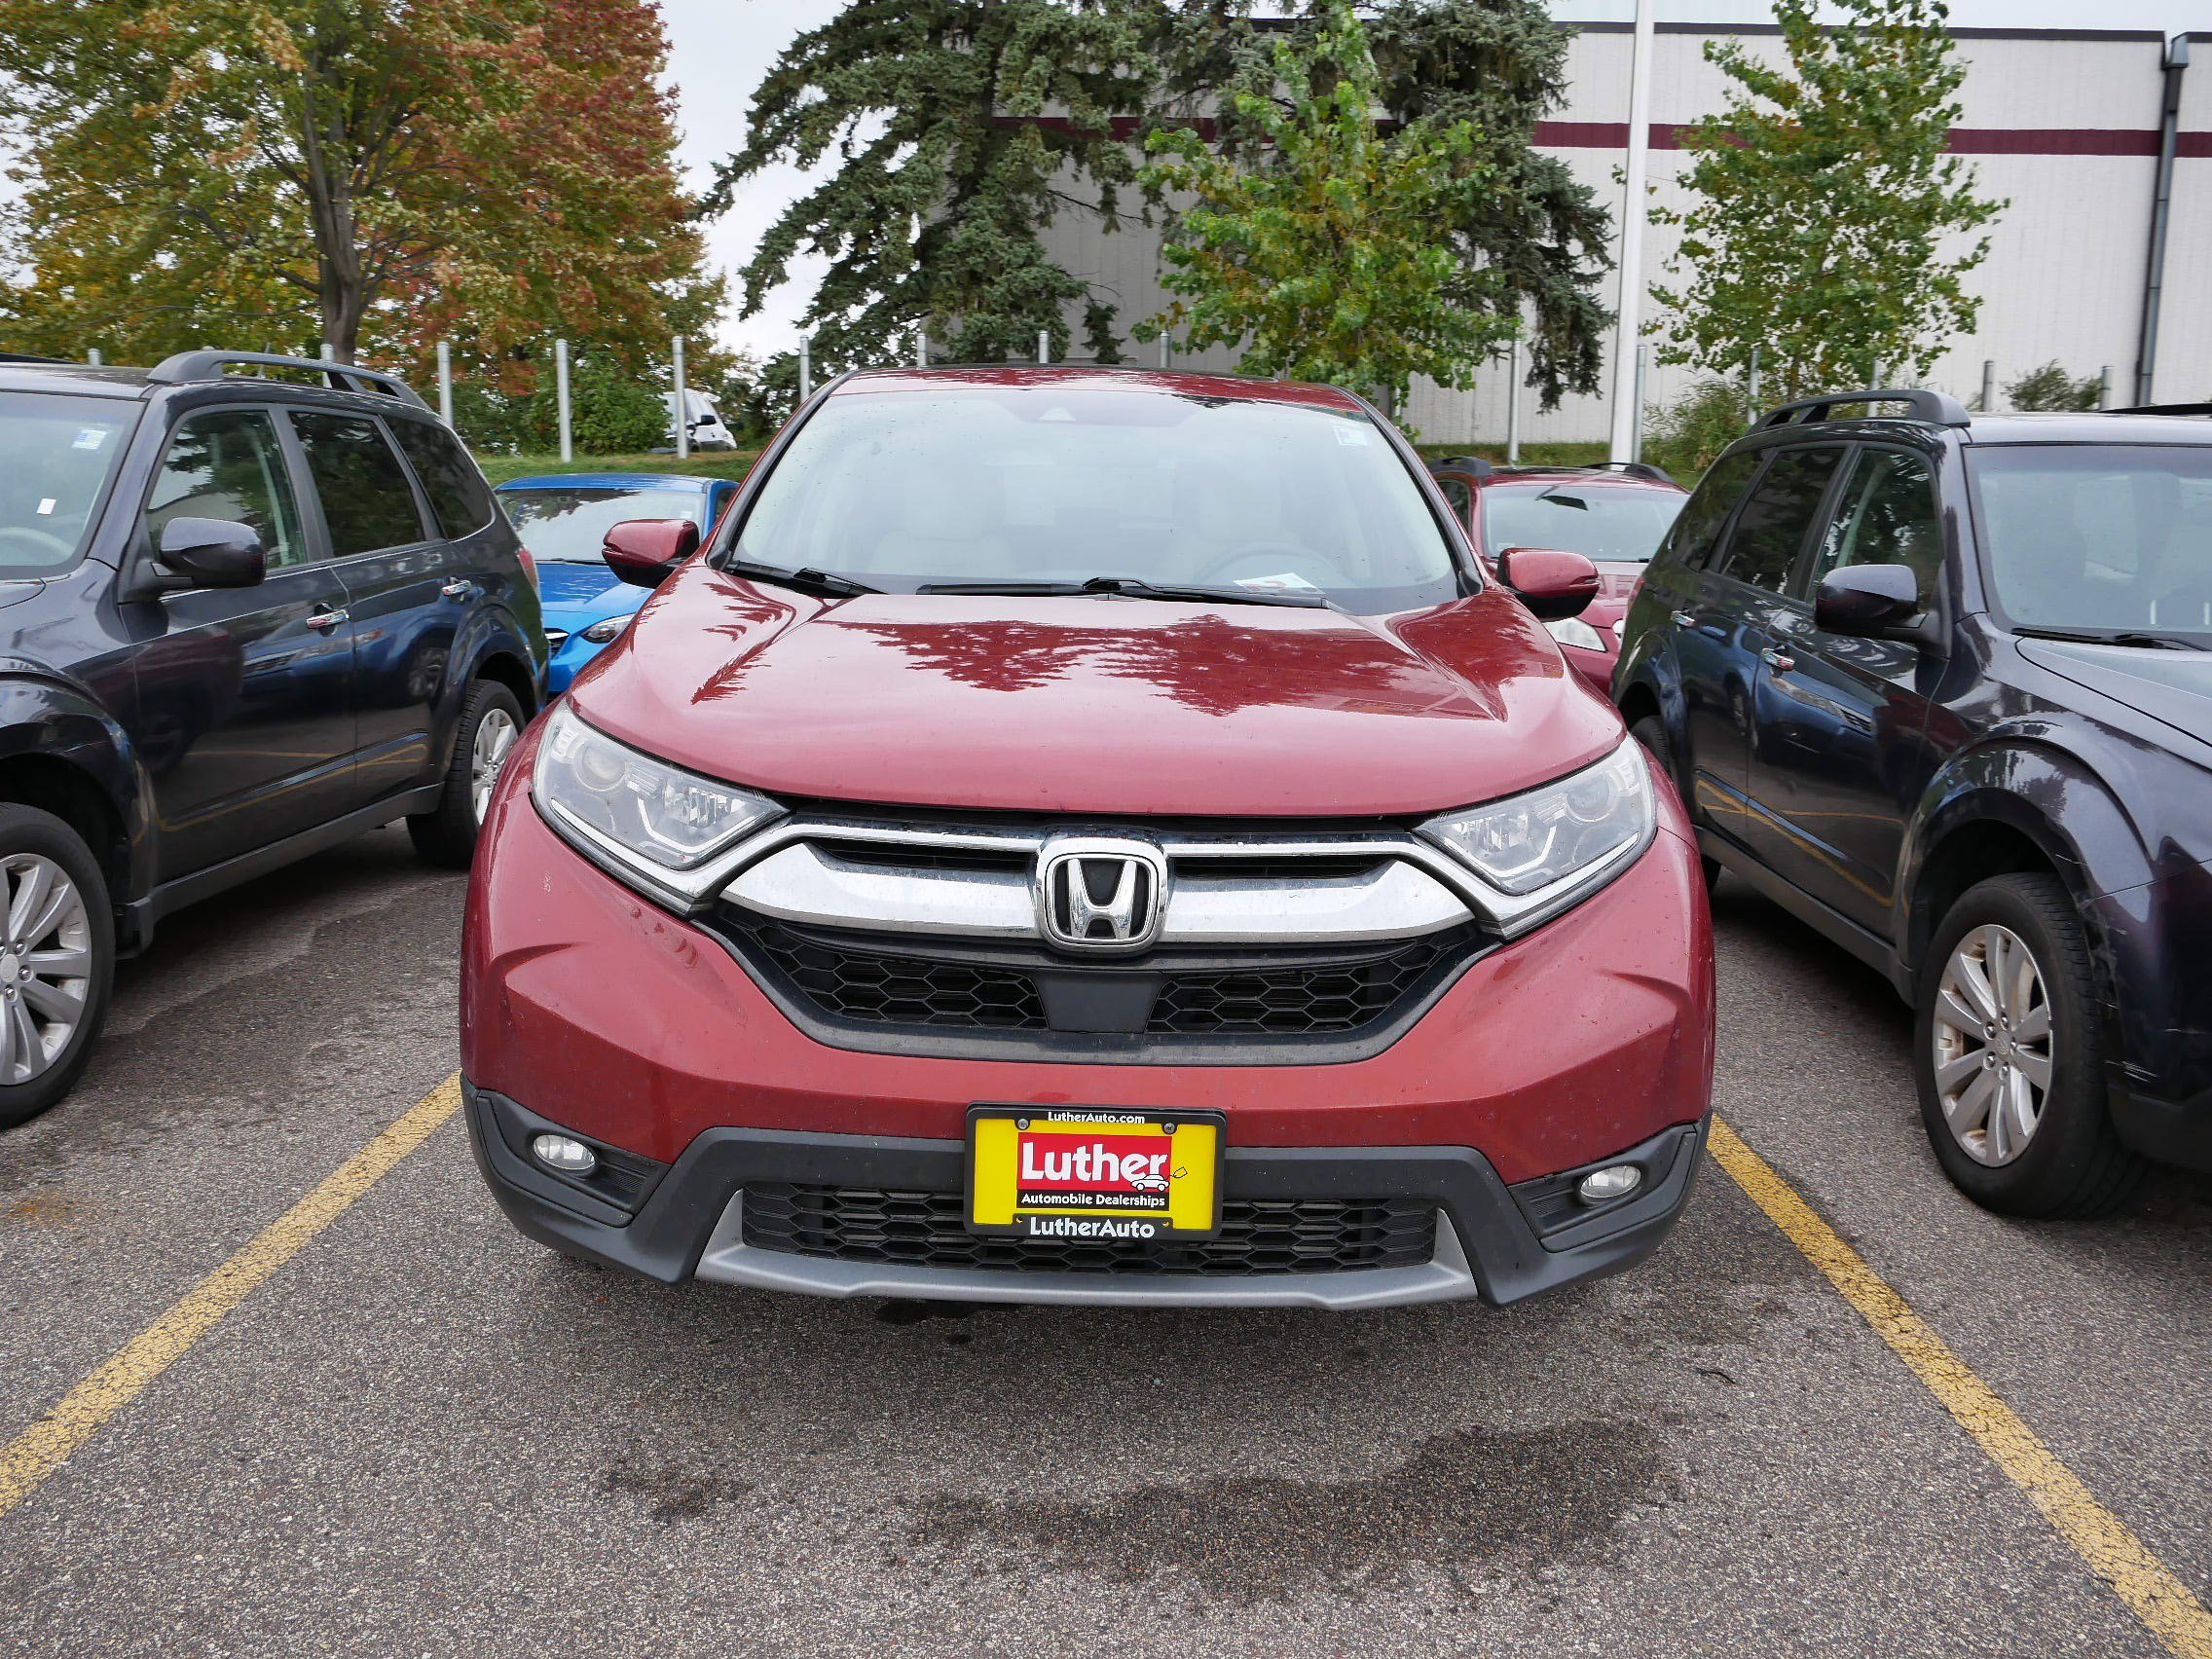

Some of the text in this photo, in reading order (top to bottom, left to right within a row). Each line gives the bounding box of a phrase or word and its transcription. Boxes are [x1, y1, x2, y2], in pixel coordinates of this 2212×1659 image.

[1048, 1111, 1145, 1124] LutherAuto.com
[1021, 1141, 1168, 1182] Luther
[1021, 1193, 1165, 1208] Automobile Dealerships
[1029, 1216, 1156, 1238] LutherAuto
